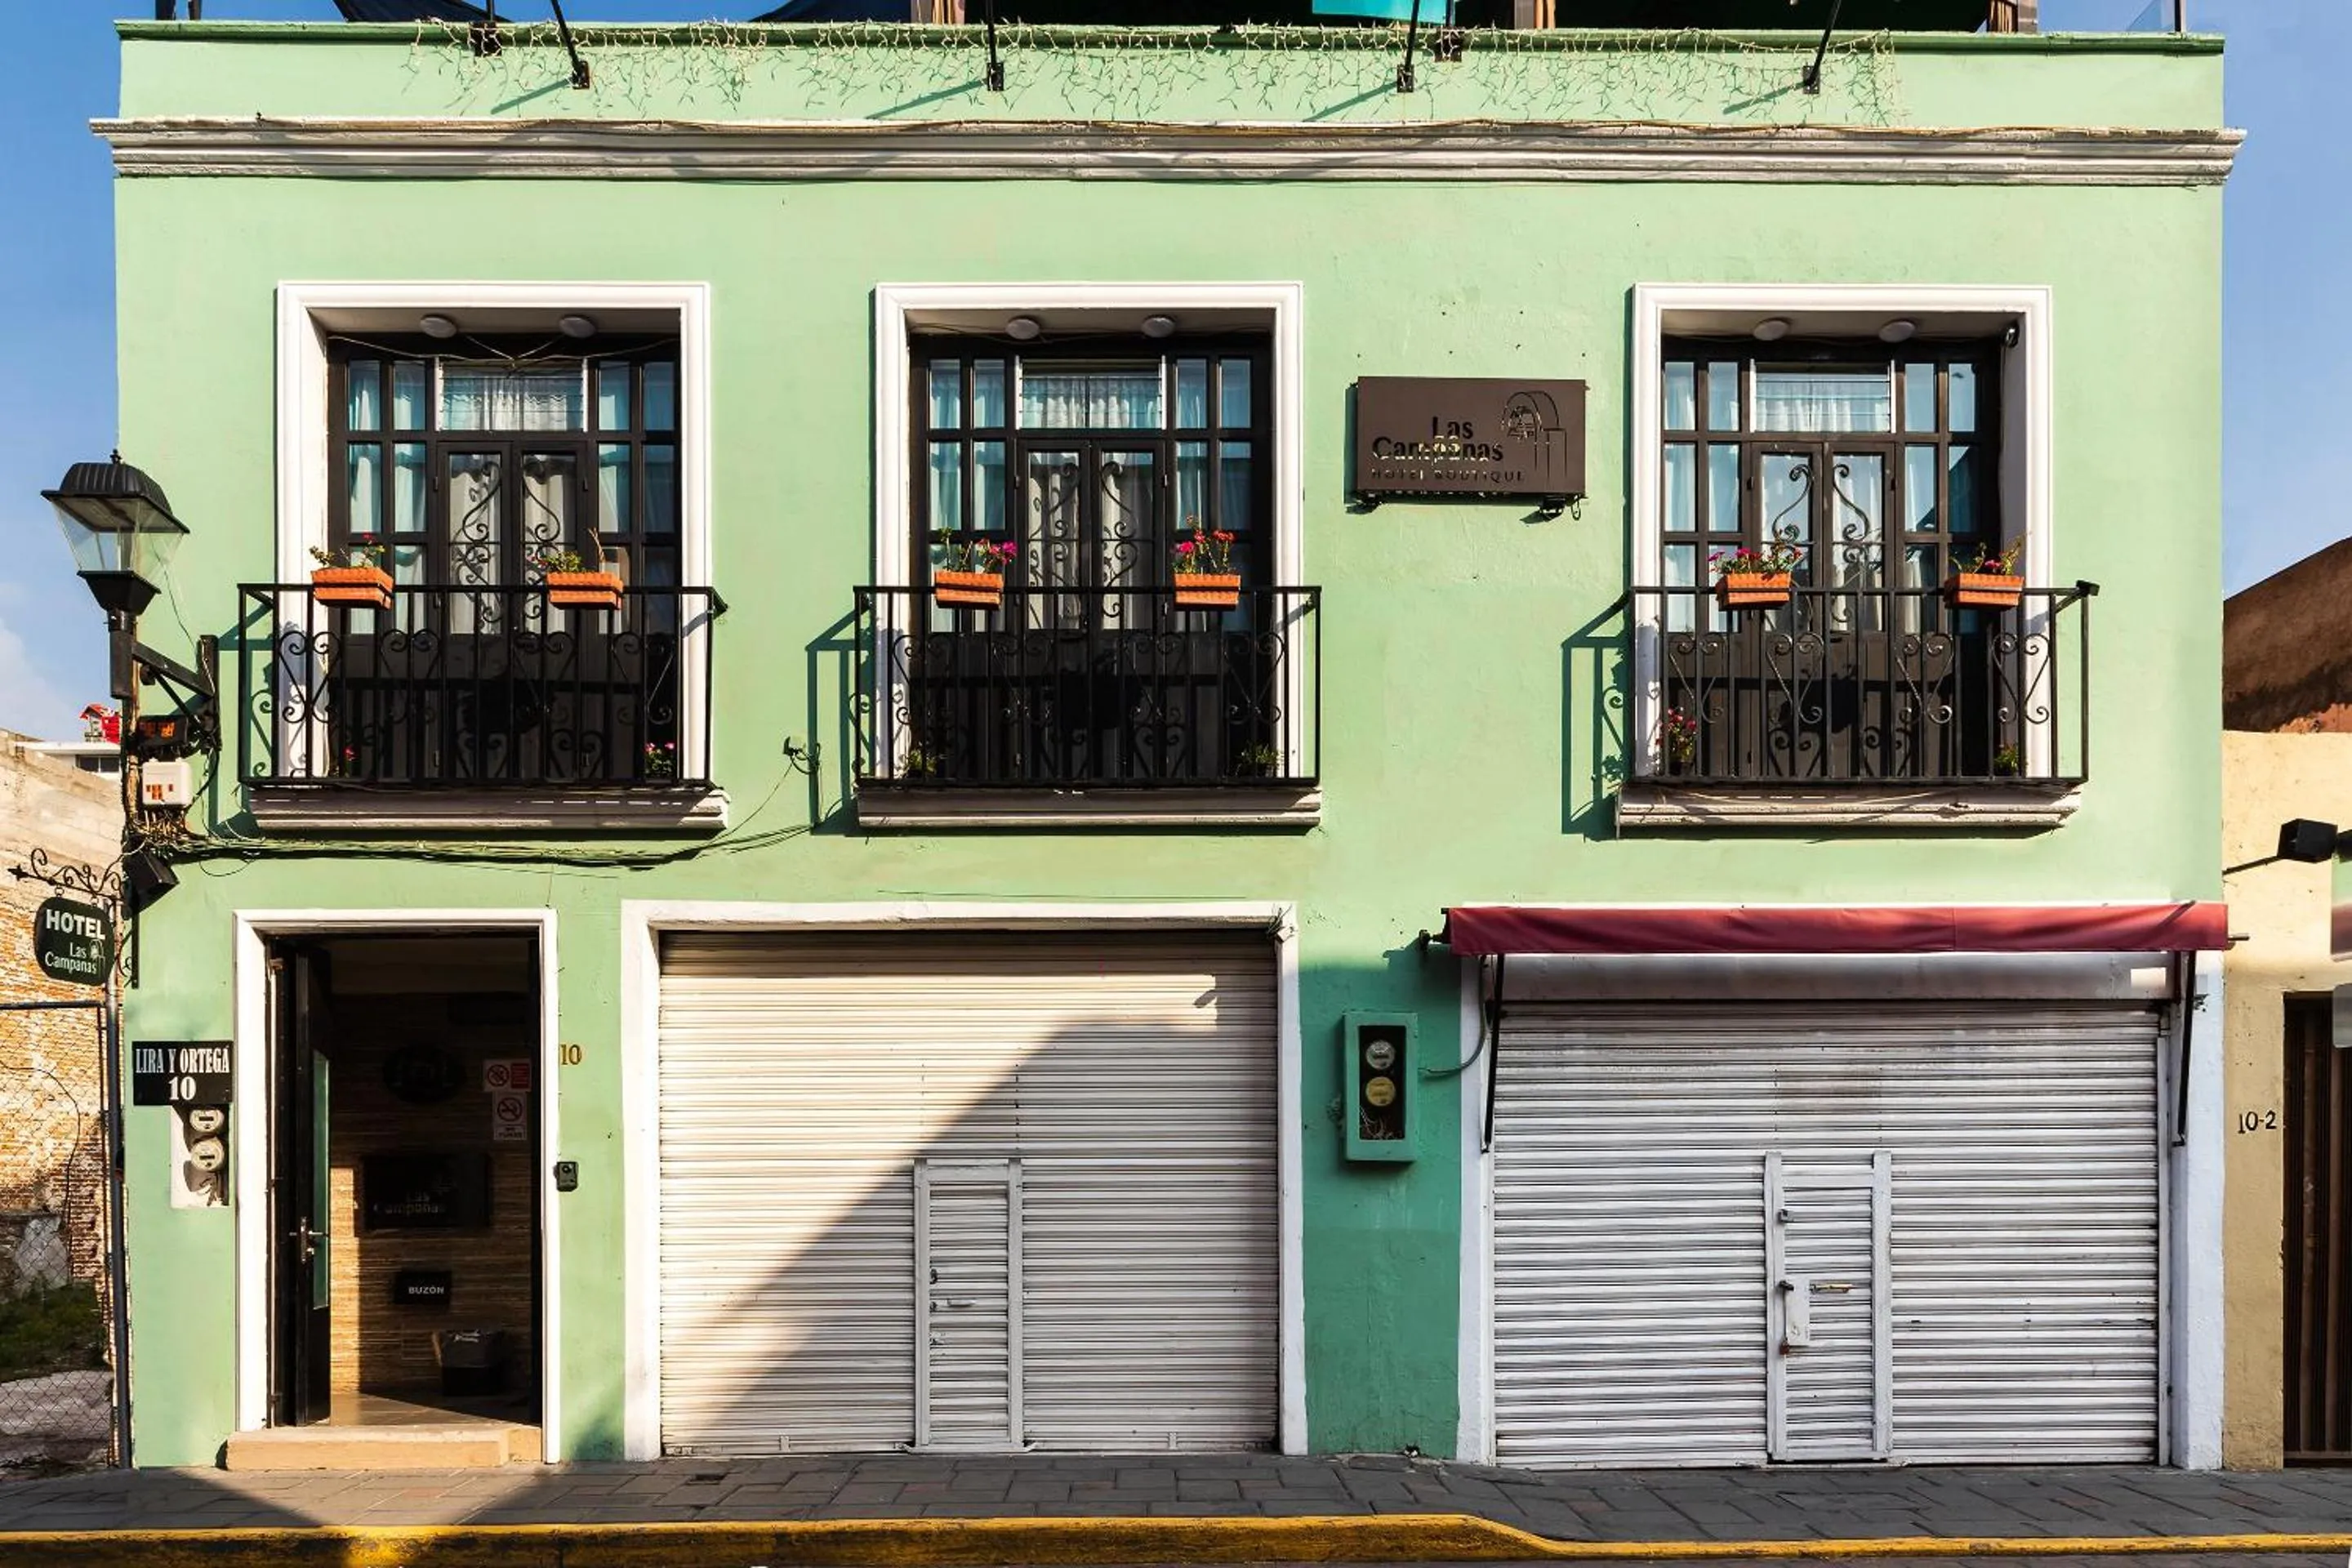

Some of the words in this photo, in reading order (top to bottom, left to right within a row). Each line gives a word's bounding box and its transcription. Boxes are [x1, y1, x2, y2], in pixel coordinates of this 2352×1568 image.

[1432, 416, 1473, 439] Las
[1372, 436, 1503, 465] Campanas
[1371, 468, 1424, 480] HOTEL
[46, 909, 105, 939] HOTEL
[69, 942, 87, 958] Las
[44, 951, 96, 974] Campanas
[136, 1049, 164, 1073] LIRA
[167, 1049, 176, 1073] Y
[560, 1044, 582, 1066] 10
[168, 1076, 197, 1101] 10
[2238, 1110, 2277, 1134] 10-2
